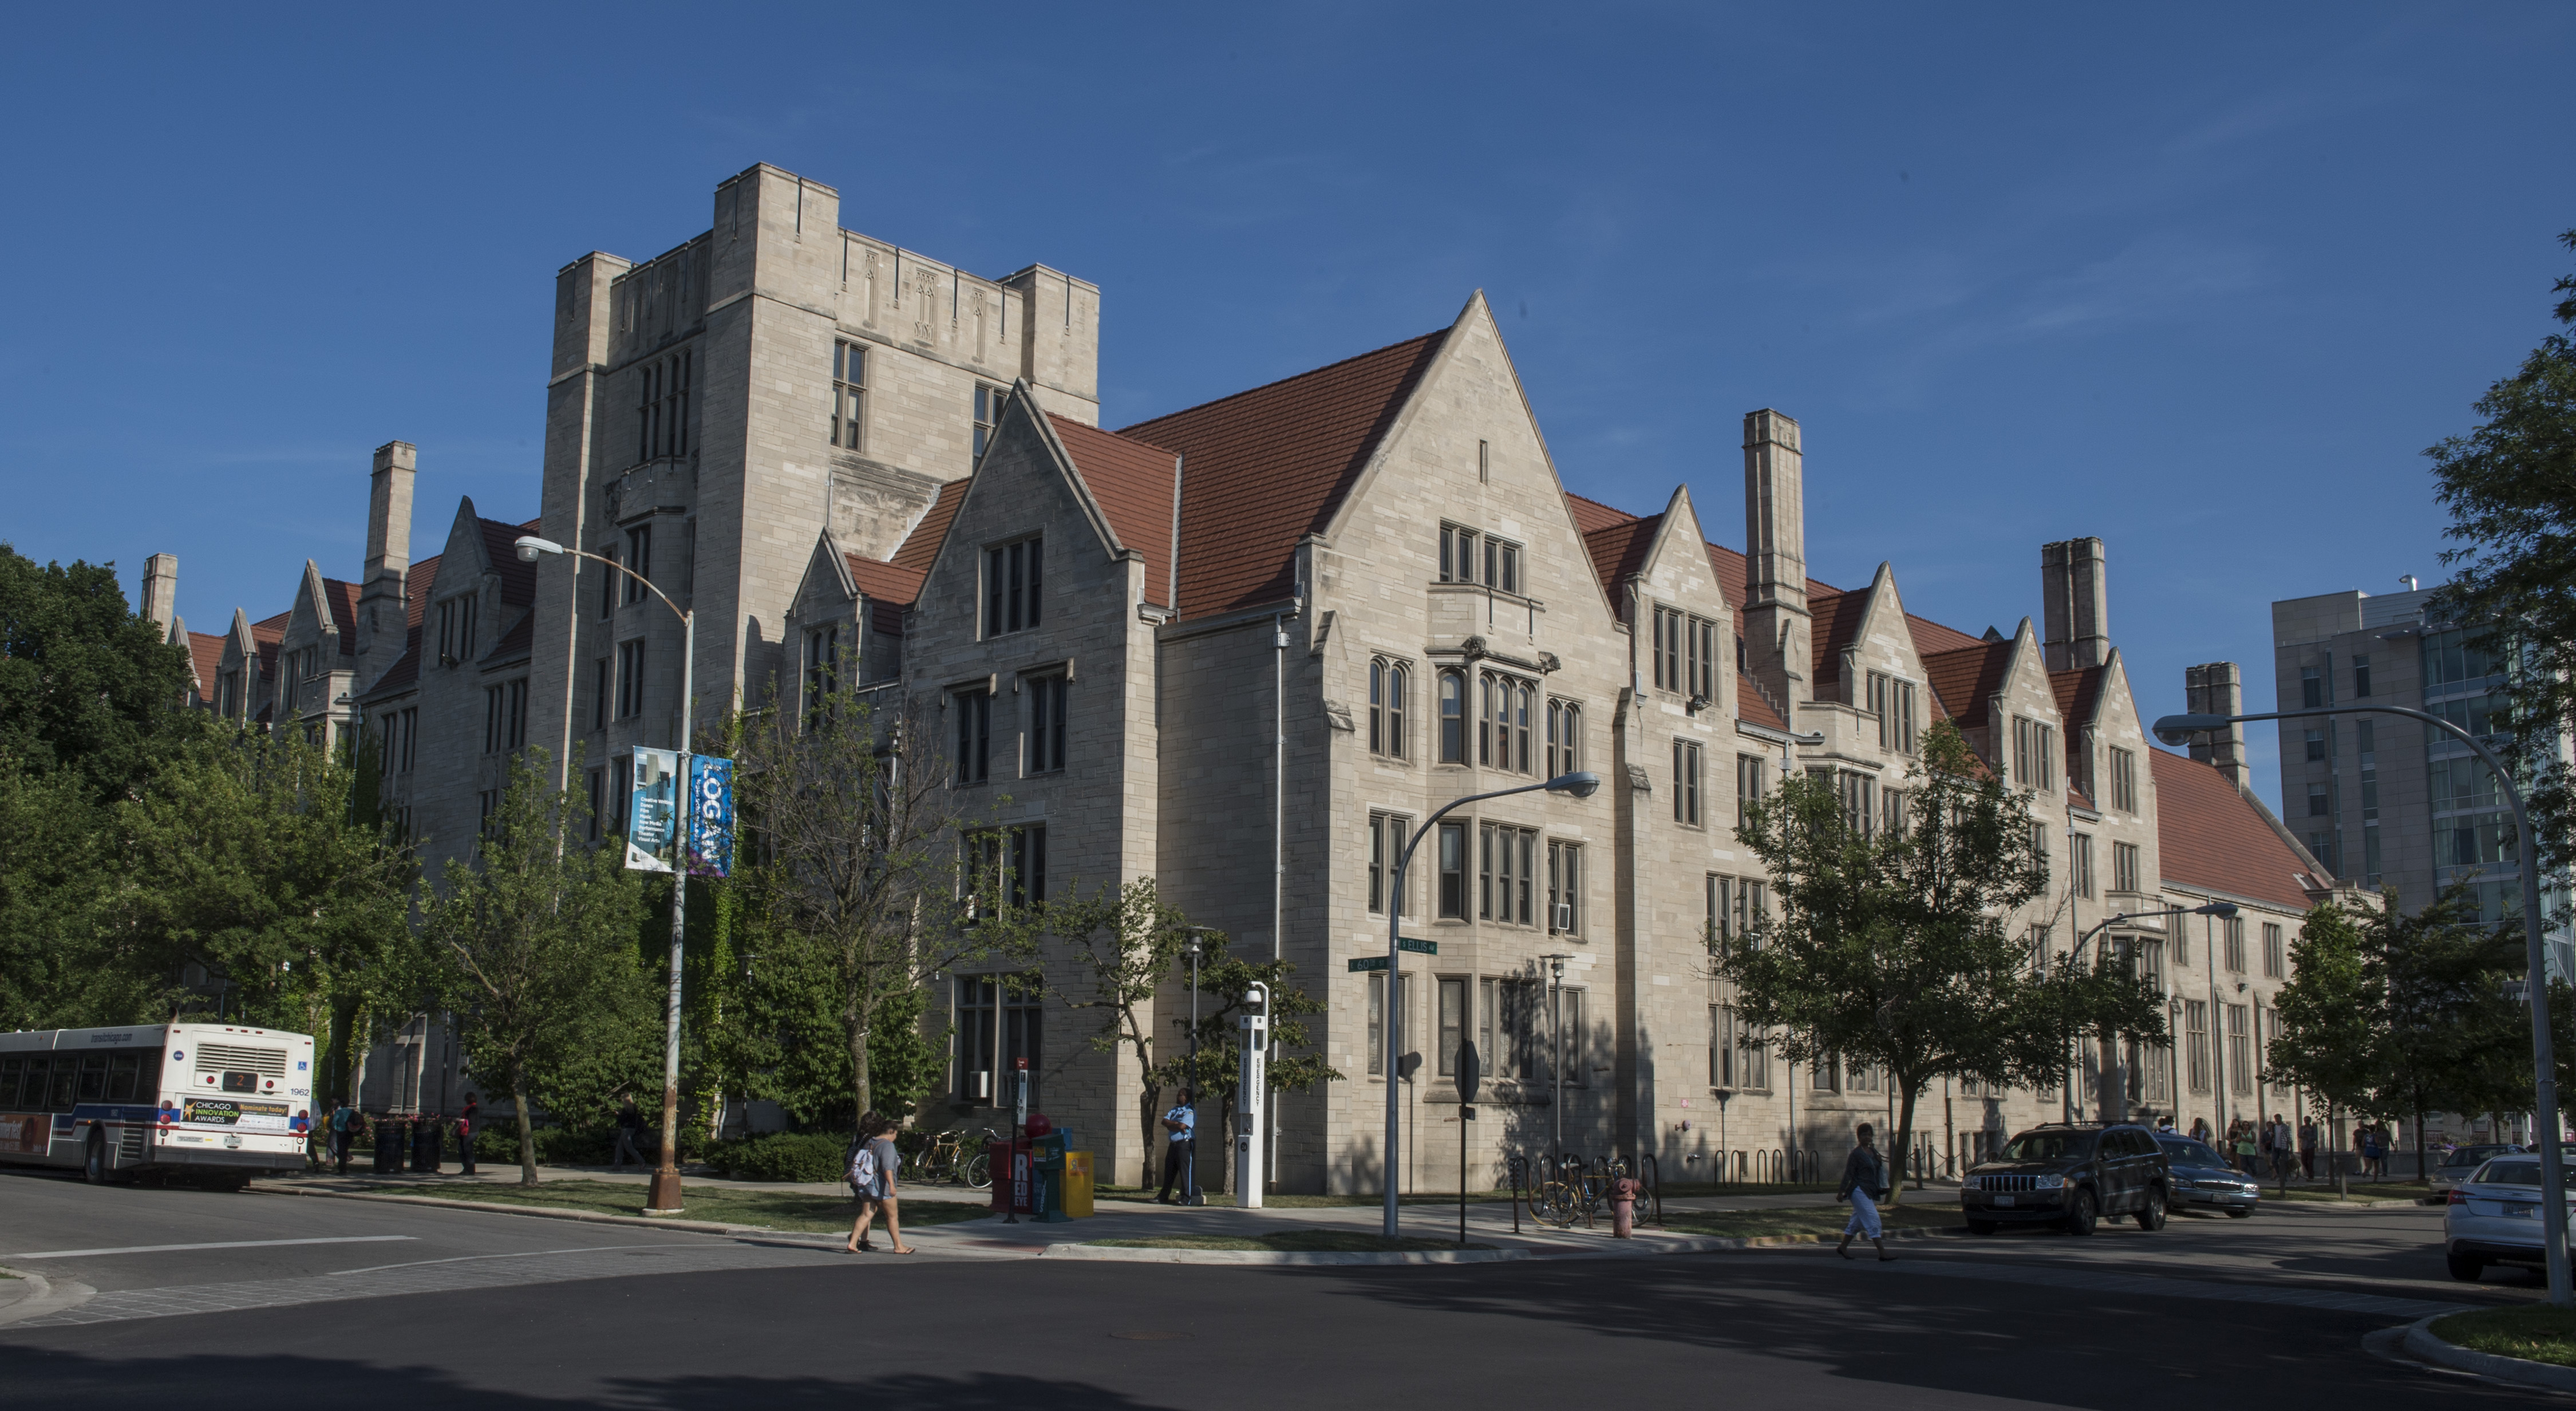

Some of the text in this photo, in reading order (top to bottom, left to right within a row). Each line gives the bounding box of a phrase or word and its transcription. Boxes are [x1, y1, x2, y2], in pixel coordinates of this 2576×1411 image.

[1408, 940, 1427, 952] ELLIS
[1357, 959, 1375, 969] 60TH
[91, 1032, 133, 1045] transitchicago.com
[236, 1075, 244, 1086] 2
[290, 1088, 310, 1096] 1962
[196, 1101, 231, 1110] CHICAGO
[240, 1103, 287, 1114] Nominate today!
[195, 1109, 239, 1117] INNOVATION
[1015, 1154, 1028, 1181] R
[1014, 1181, 1028, 1196] ED
[1014, 1196, 1028, 1207] EYE
